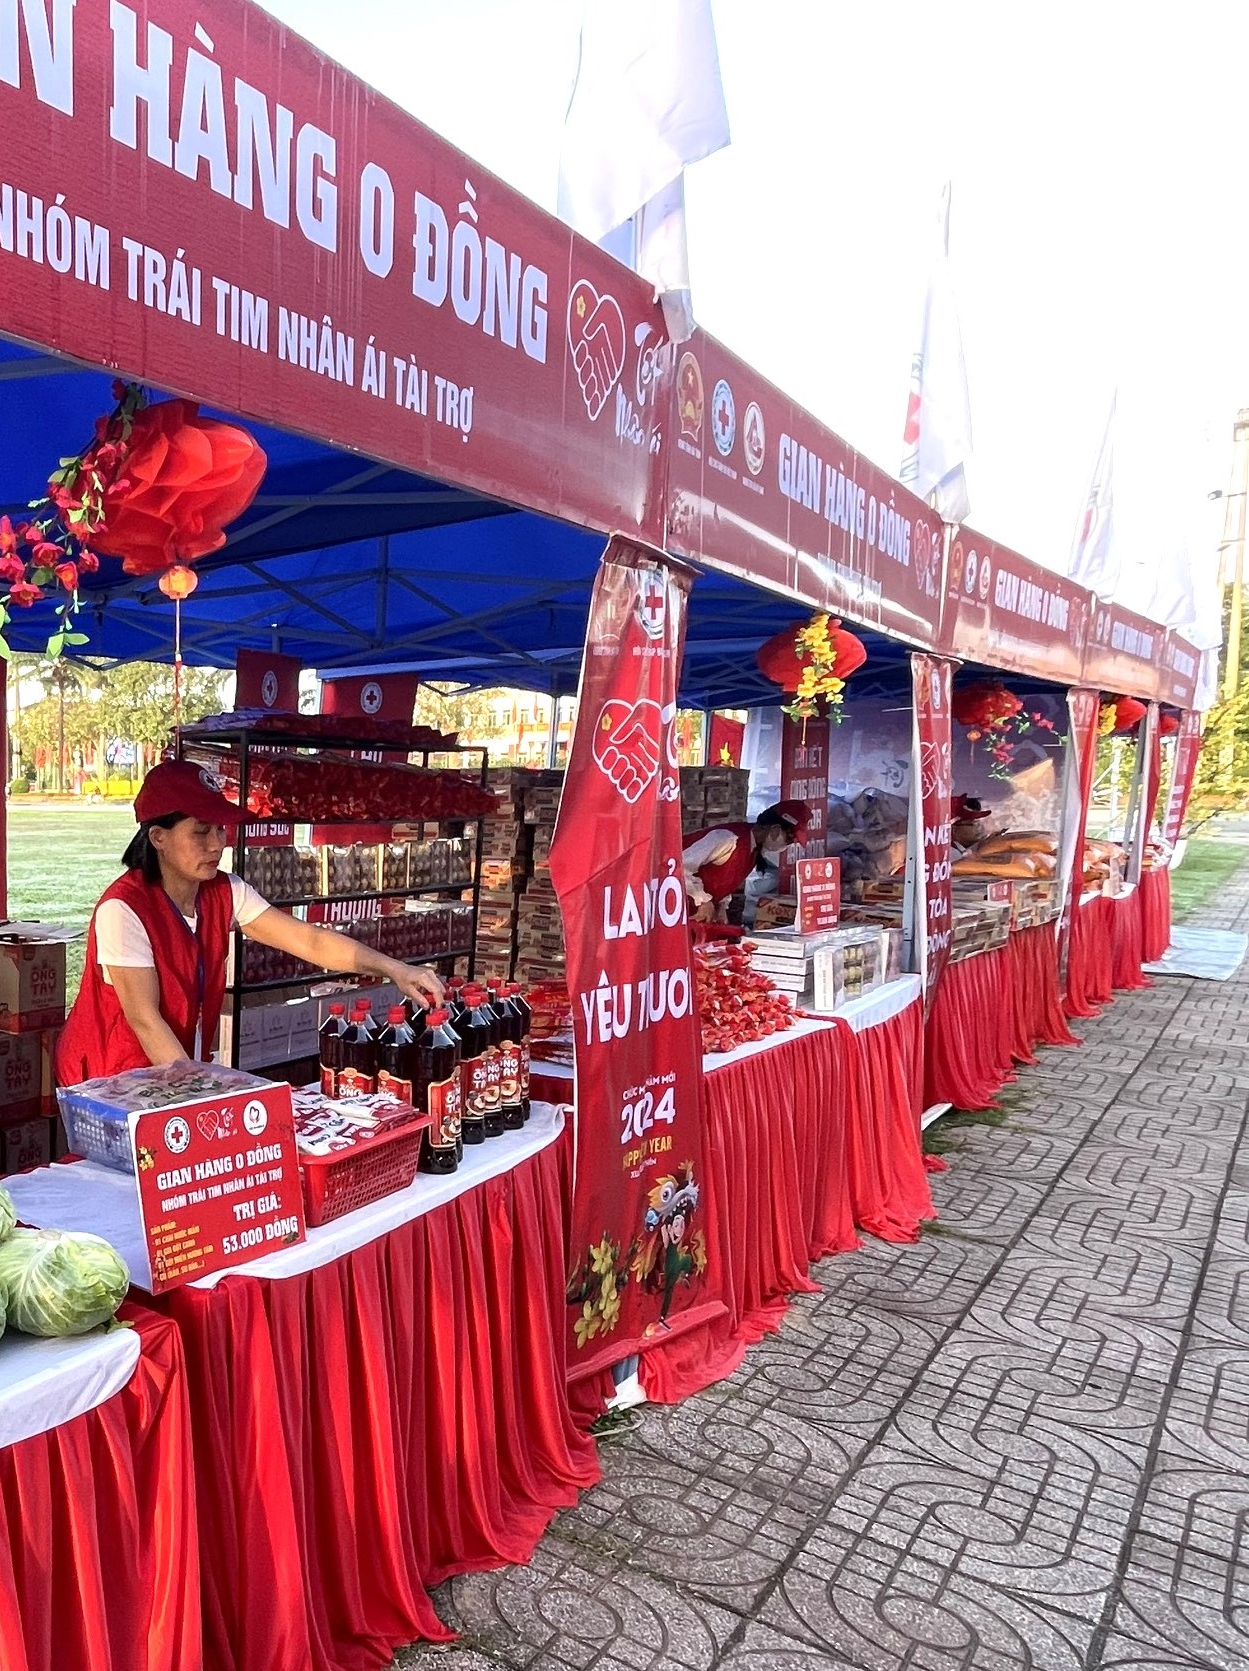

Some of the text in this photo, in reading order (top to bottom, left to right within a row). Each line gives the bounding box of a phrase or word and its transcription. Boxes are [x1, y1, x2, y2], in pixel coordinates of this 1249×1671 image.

[110, 0, 338, 253] HÀNG
[411, 179, 548, 364] ĐỒNG
[121, 246, 202, 327] TRÁI
[213, 275, 269, 355] TIM
[278, 306, 355, 386] NHÂN
[362, 334, 387, 399] ÁI
[395, 352, 430, 416] TÀI
[435, 375, 474, 443] TRỢ
[778, 432, 822, 524] GIAN
[824, 460, 866, 540] HÀNG
[878, 489, 911, 567] ĐỒNG
[580, 969, 632, 1045] YÊU
[621, 1087, 676, 1145] 2024
[156, 1166, 192, 1191] GIAN
[195, 1157, 233, 1180] HÀNG
[246, 1142, 283, 1167] ĐỒNG
[649, 1136, 673, 1154] YEAR
[161, 1193, 187, 1213] NHÓM
[188, 1188, 206, 1205] TRÁI
[207, 1185, 222, 1200] TIM
[233, 1191, 282, 1222] TRỊ GIÁ:
[222, 1215, 299, 1255] 53.000 ĐỒNG
